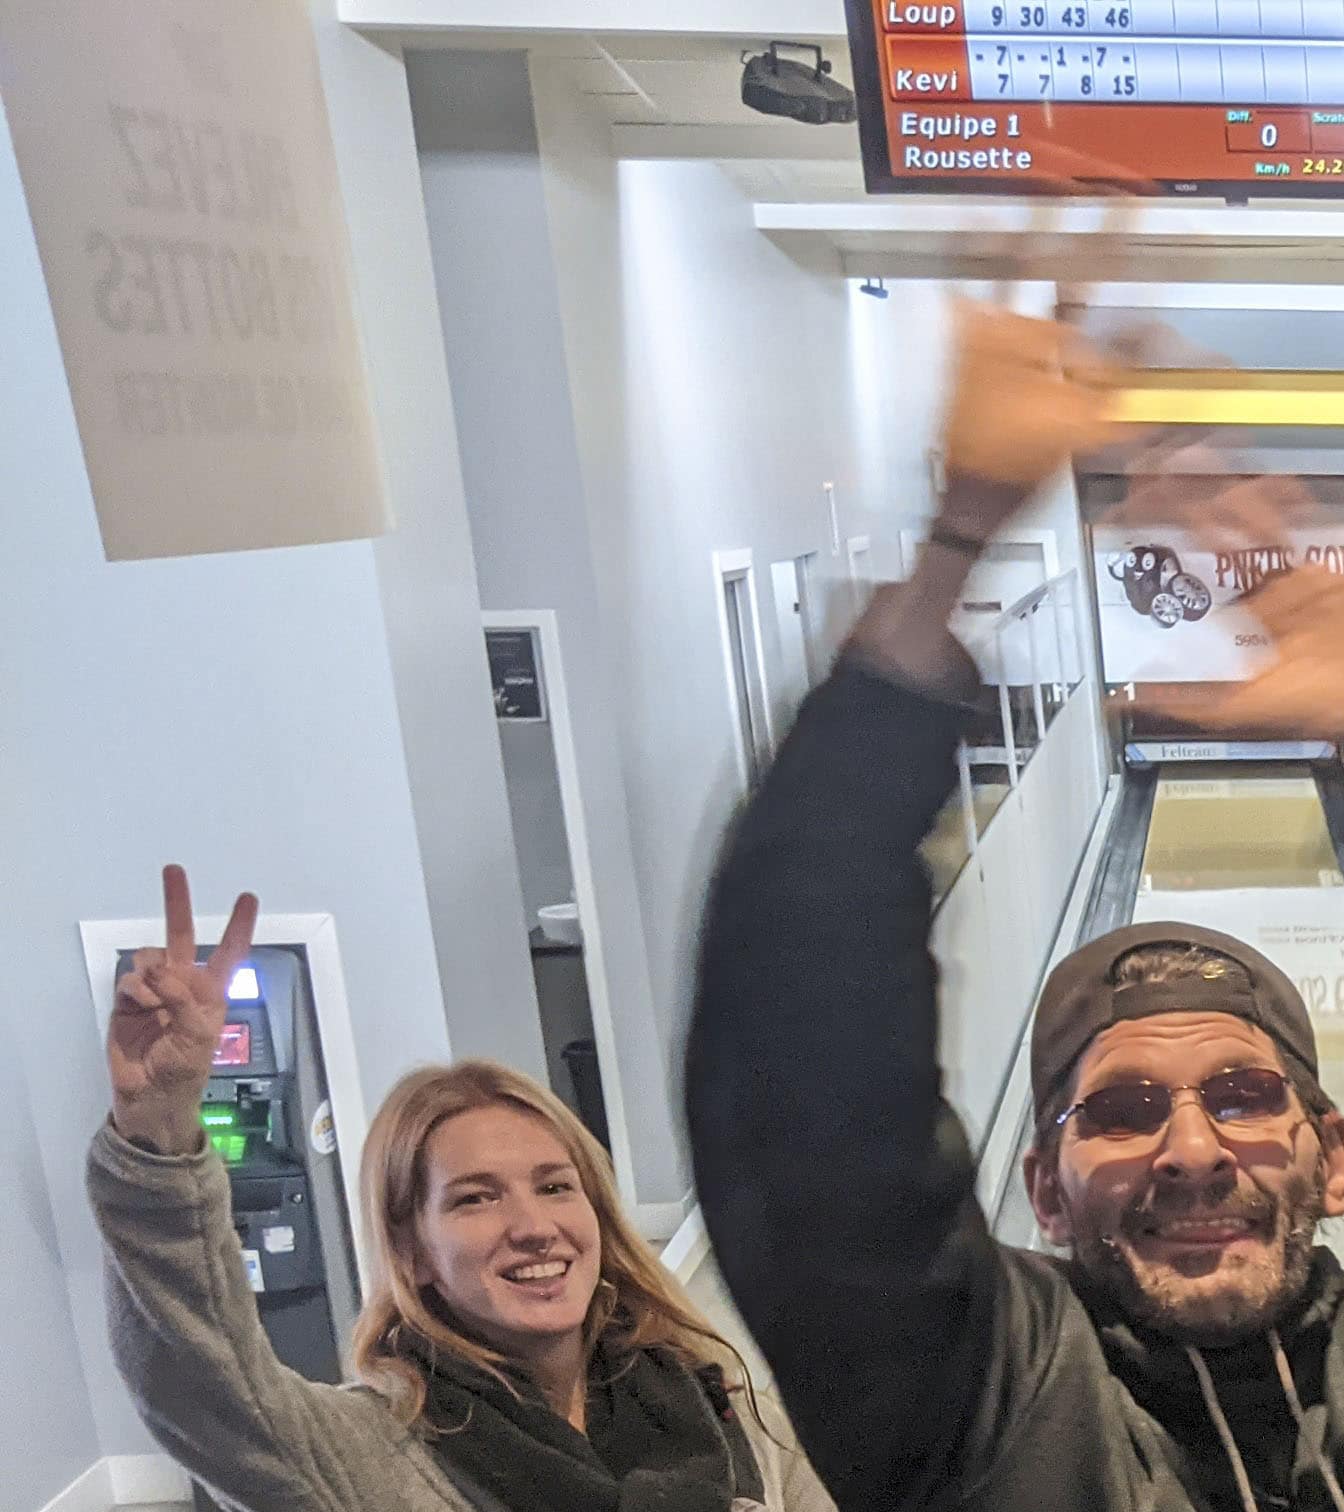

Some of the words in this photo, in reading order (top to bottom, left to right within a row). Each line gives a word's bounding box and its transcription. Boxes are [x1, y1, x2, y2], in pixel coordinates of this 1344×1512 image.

[888, 1, 956, 28] Loup
[991, 6, 1003, 27] 9
[1020, 7, 1044, 27] 30
[1062, 8, 1086, 28] 43
[1105, 8, 1129, 28] 46
[896, 69, 957, 92] Kevi
[998, 74, 1009, 93] 7
[1039, 75, 1050, 94] 7
[1080, 75, 1092, 95] 8
[1113, 76, 1135, 95] 15
[901, 113, 997, 139] Equipe
[1007, 115, 1020, 136] 1
[1261, 124, 1277, 147] 0
[904, 146, 1032, 169] Rousette
[1123, 682, 1135, 702] 1
